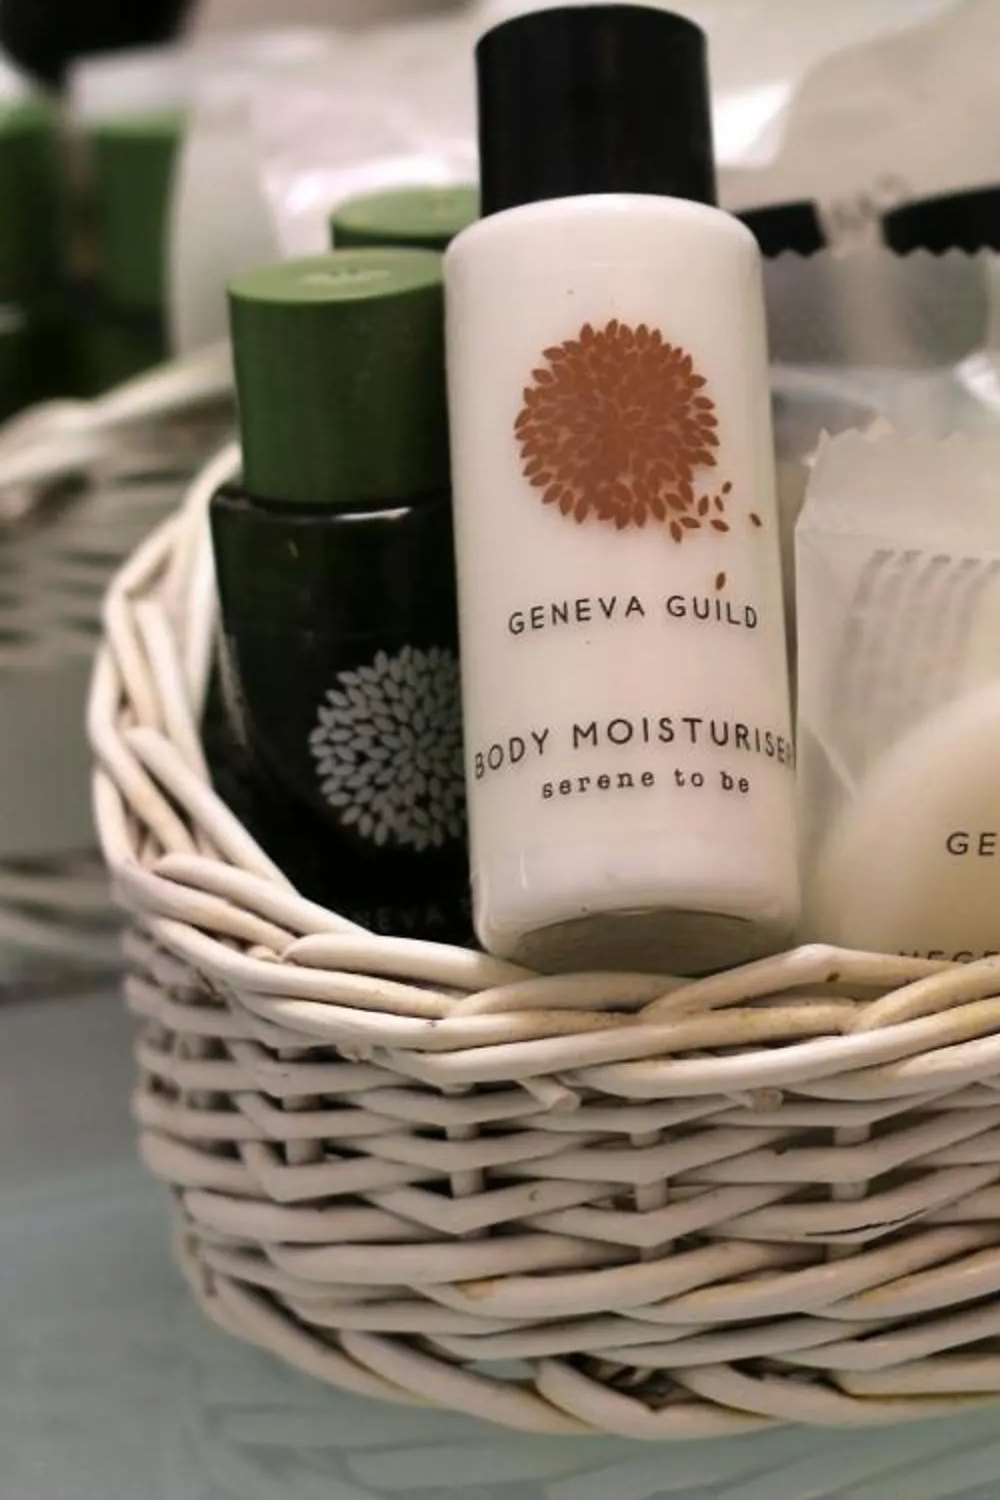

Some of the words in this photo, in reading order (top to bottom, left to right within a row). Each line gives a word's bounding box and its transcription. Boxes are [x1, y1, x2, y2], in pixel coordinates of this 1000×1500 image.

[508, 596, 646, 635] GENEVA
[666, 595, 758, 629] GUILD
[474, 728, 550, 780] BODY
[541, 771, 656, 799] serene
[674, 768, 705, 788] to
[720, 771, 750, 793] be
